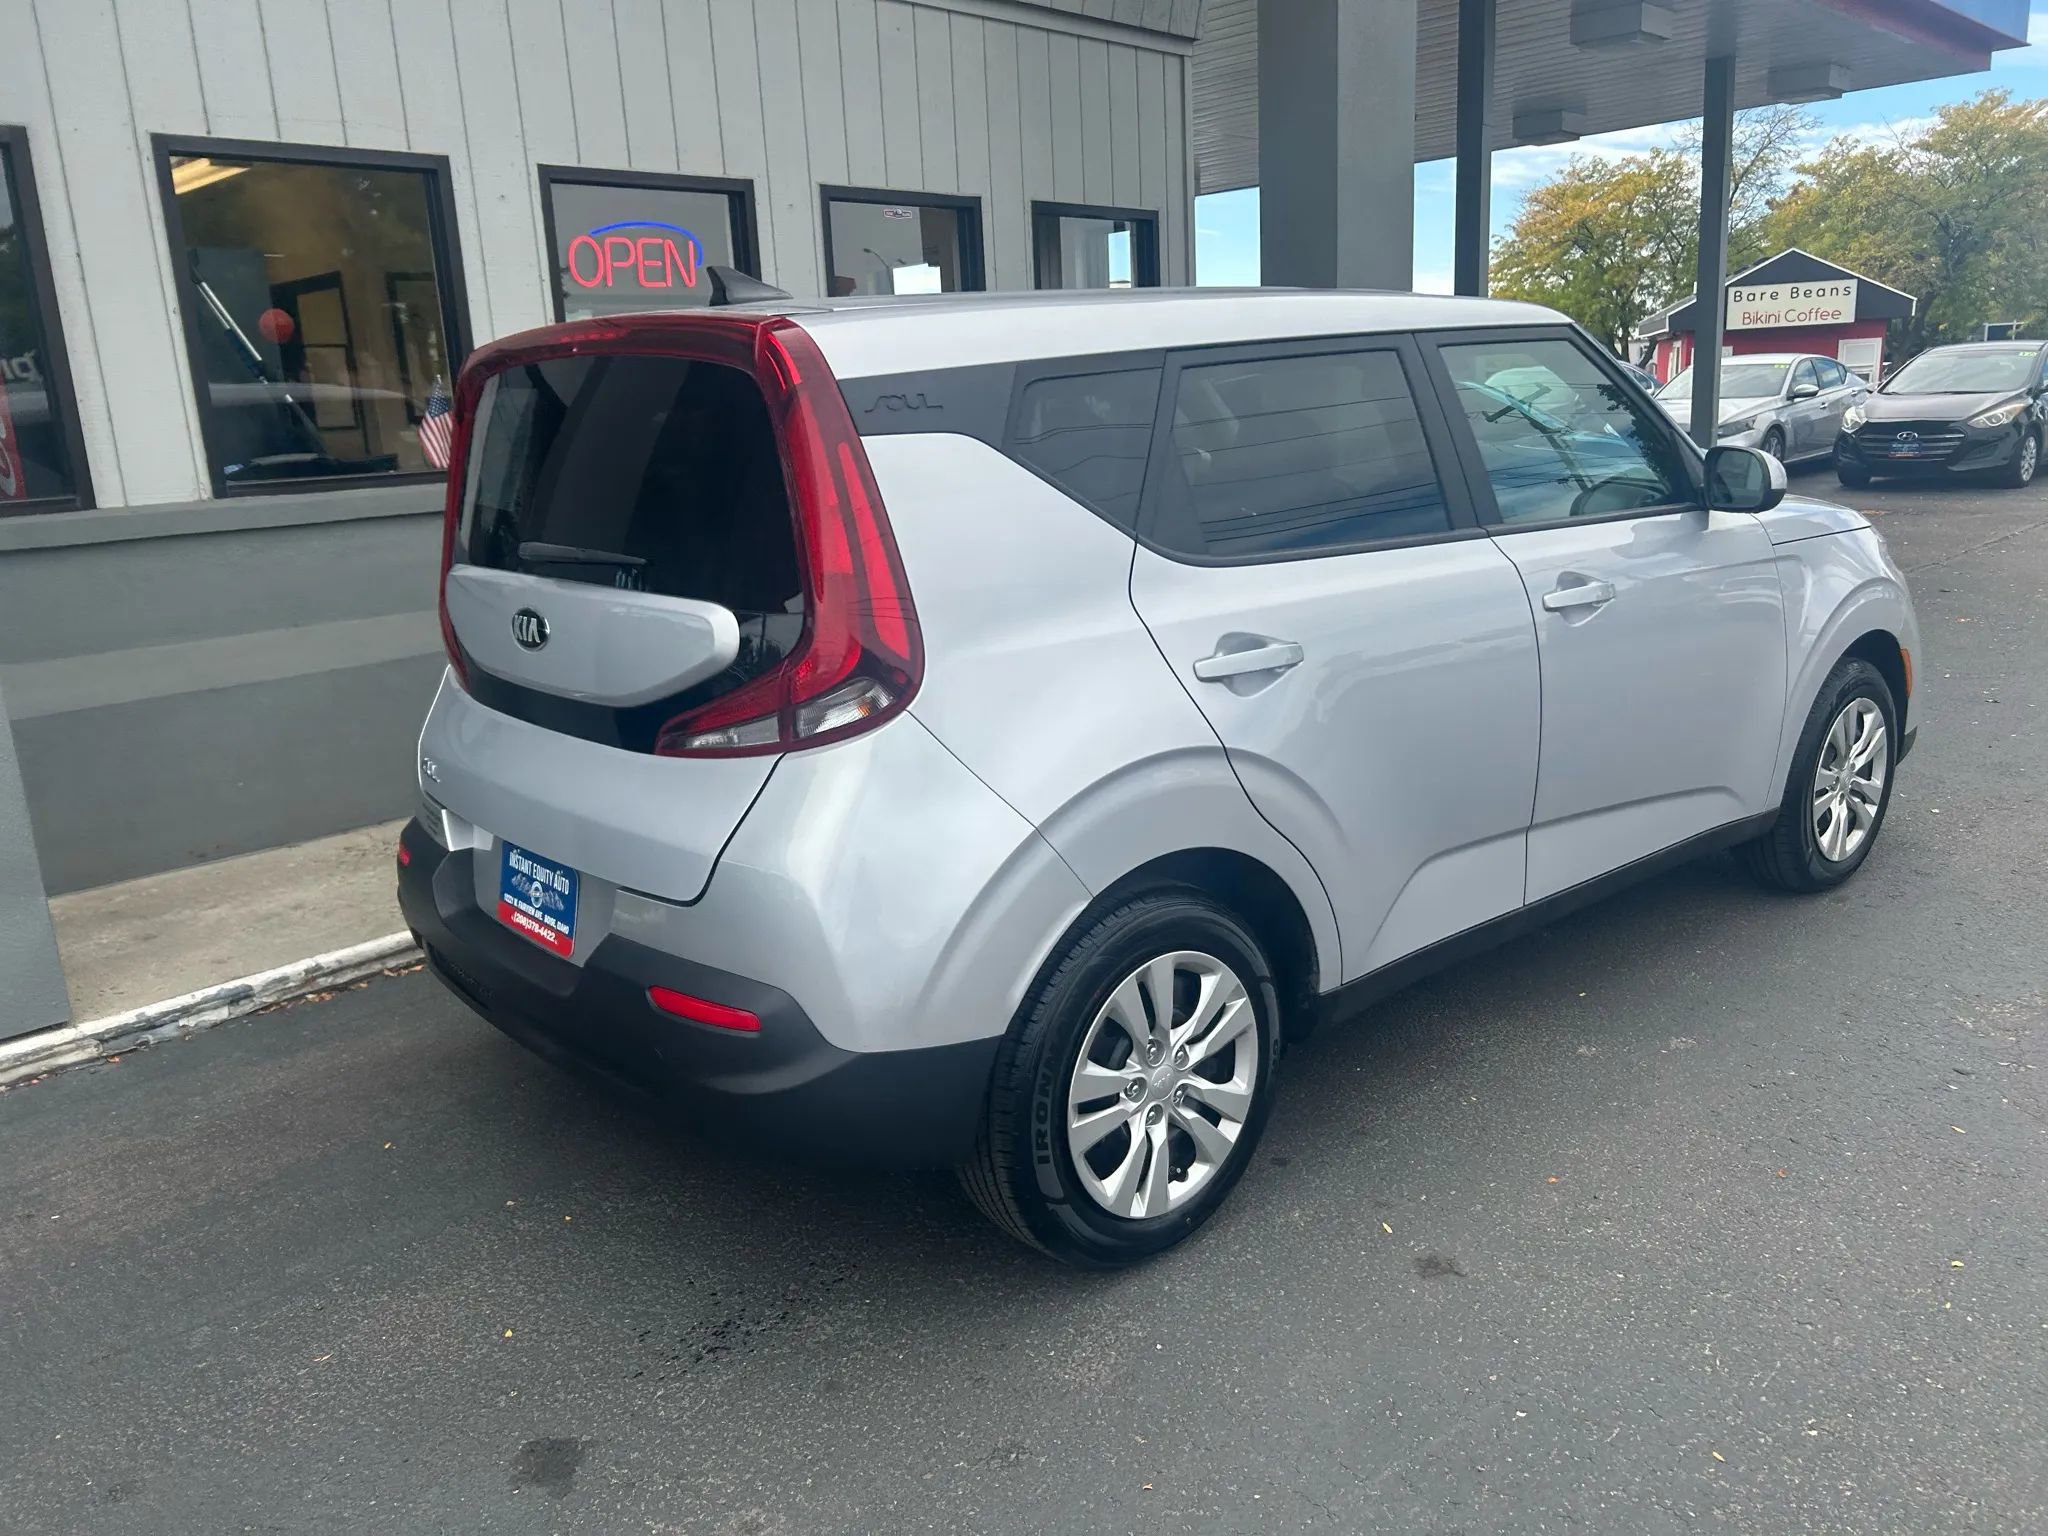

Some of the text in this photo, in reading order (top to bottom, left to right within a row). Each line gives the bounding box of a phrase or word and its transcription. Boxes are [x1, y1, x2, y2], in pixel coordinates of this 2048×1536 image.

[568, 235, 696, 288] OPEN
[1733, 285, 1852, 303] Bare Beans
[1742, 307, 1842, 325] Bikini Coffee
[513, 614, 541, 643] KIA
[509, 851, 570, 895] INSTANT EQUITY AUTO
